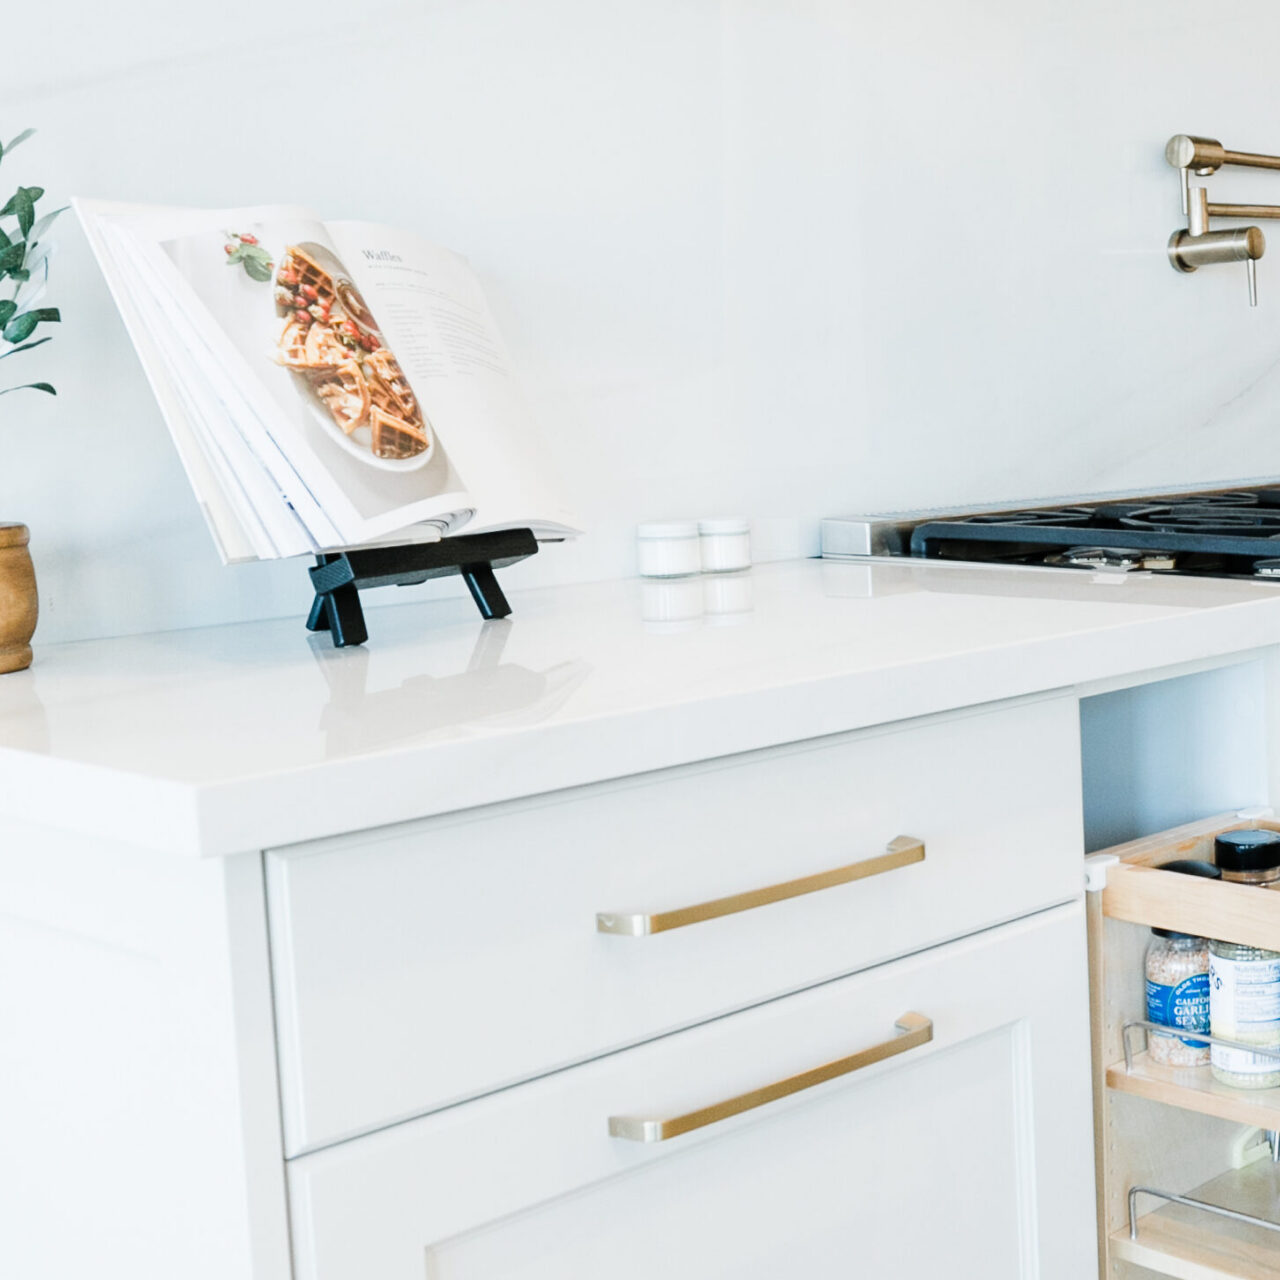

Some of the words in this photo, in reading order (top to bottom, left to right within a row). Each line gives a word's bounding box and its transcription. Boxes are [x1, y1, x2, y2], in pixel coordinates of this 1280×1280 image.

[361, 250, 403, 263] Waffles
[1175, 996, 1209, 1006] CALIFO
[1174, 1004, 1209, 1016] GARLI
